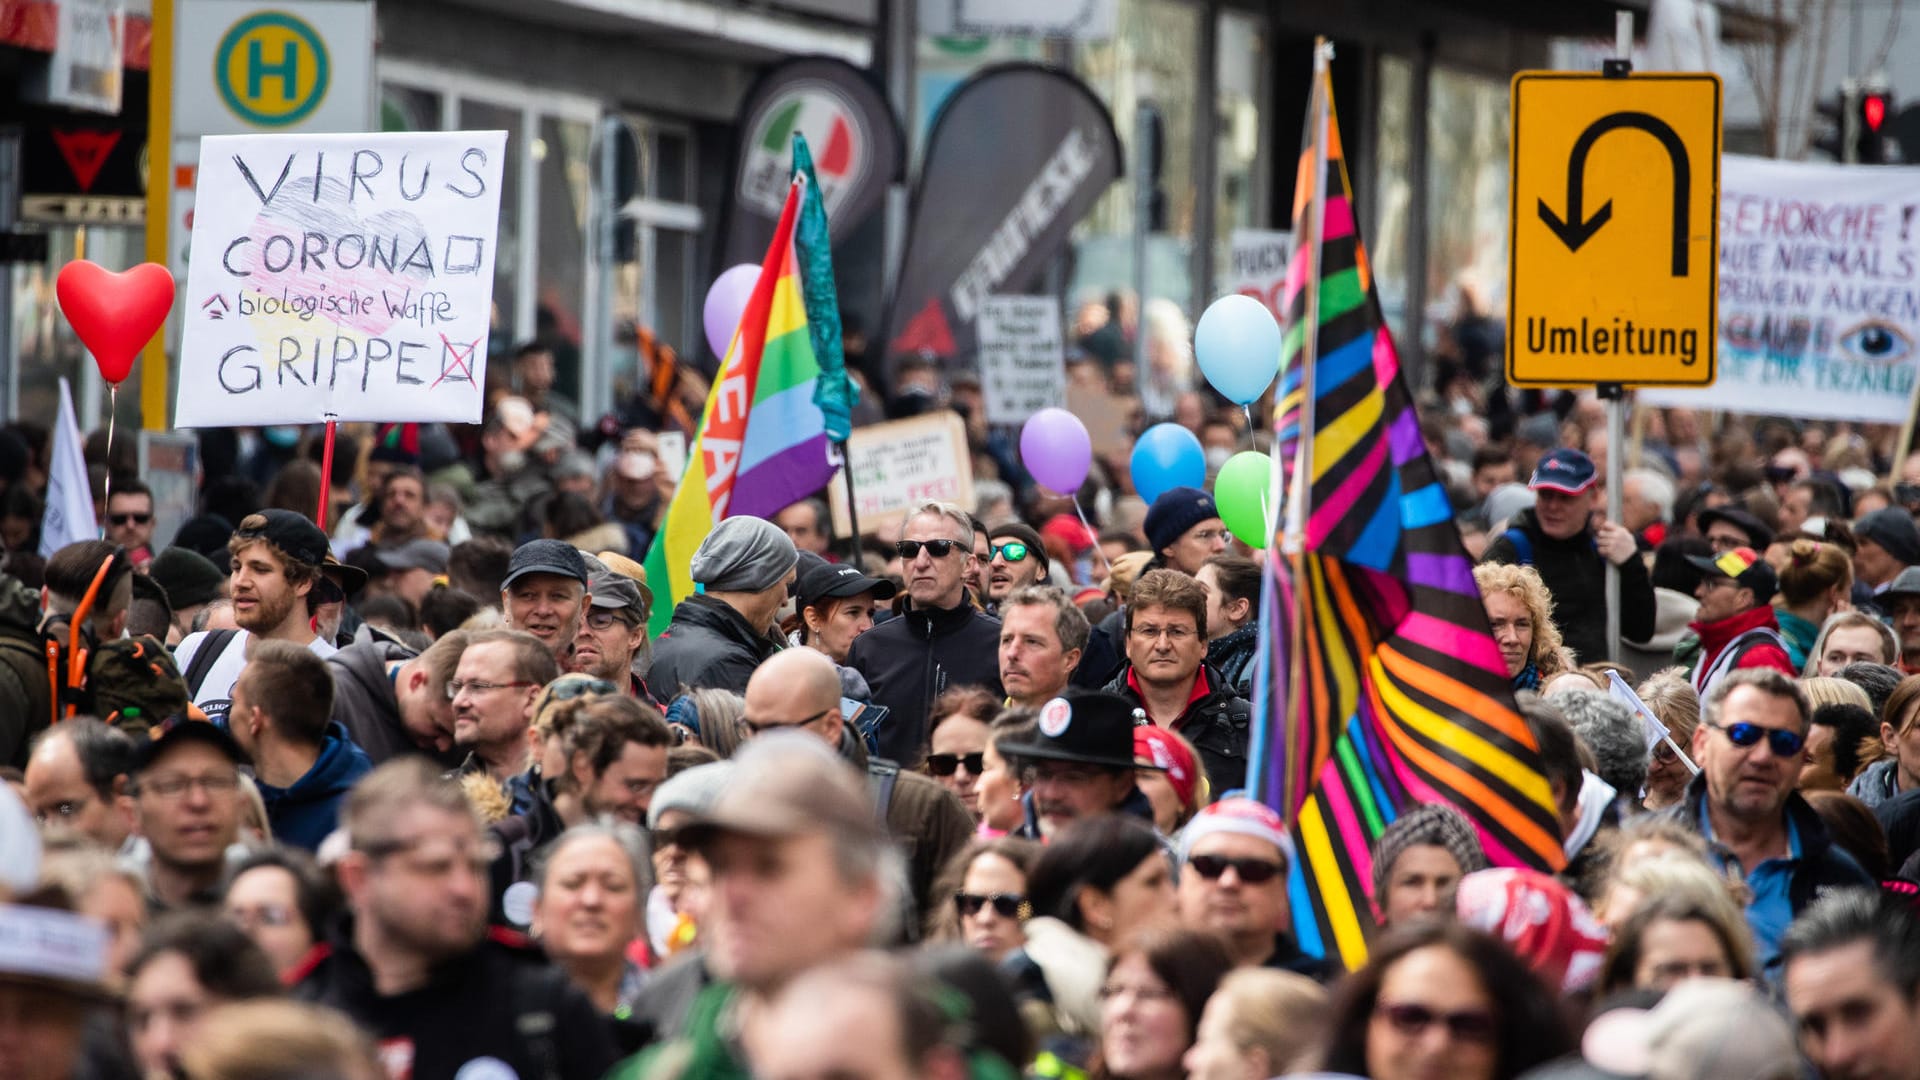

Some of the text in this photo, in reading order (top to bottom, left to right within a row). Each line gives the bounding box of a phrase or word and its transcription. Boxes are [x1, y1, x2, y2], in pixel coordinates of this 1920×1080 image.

[248, 39, 298, 101] H
[232, 147, 487, 206] VIRUS
[222, 231, 436, 278] CORONA
[239, 284, 457, 328] biologische Waffe
[218, 336, 430, 394] GRIPPE
[1528, 317, 1697, 366] Umleitung
